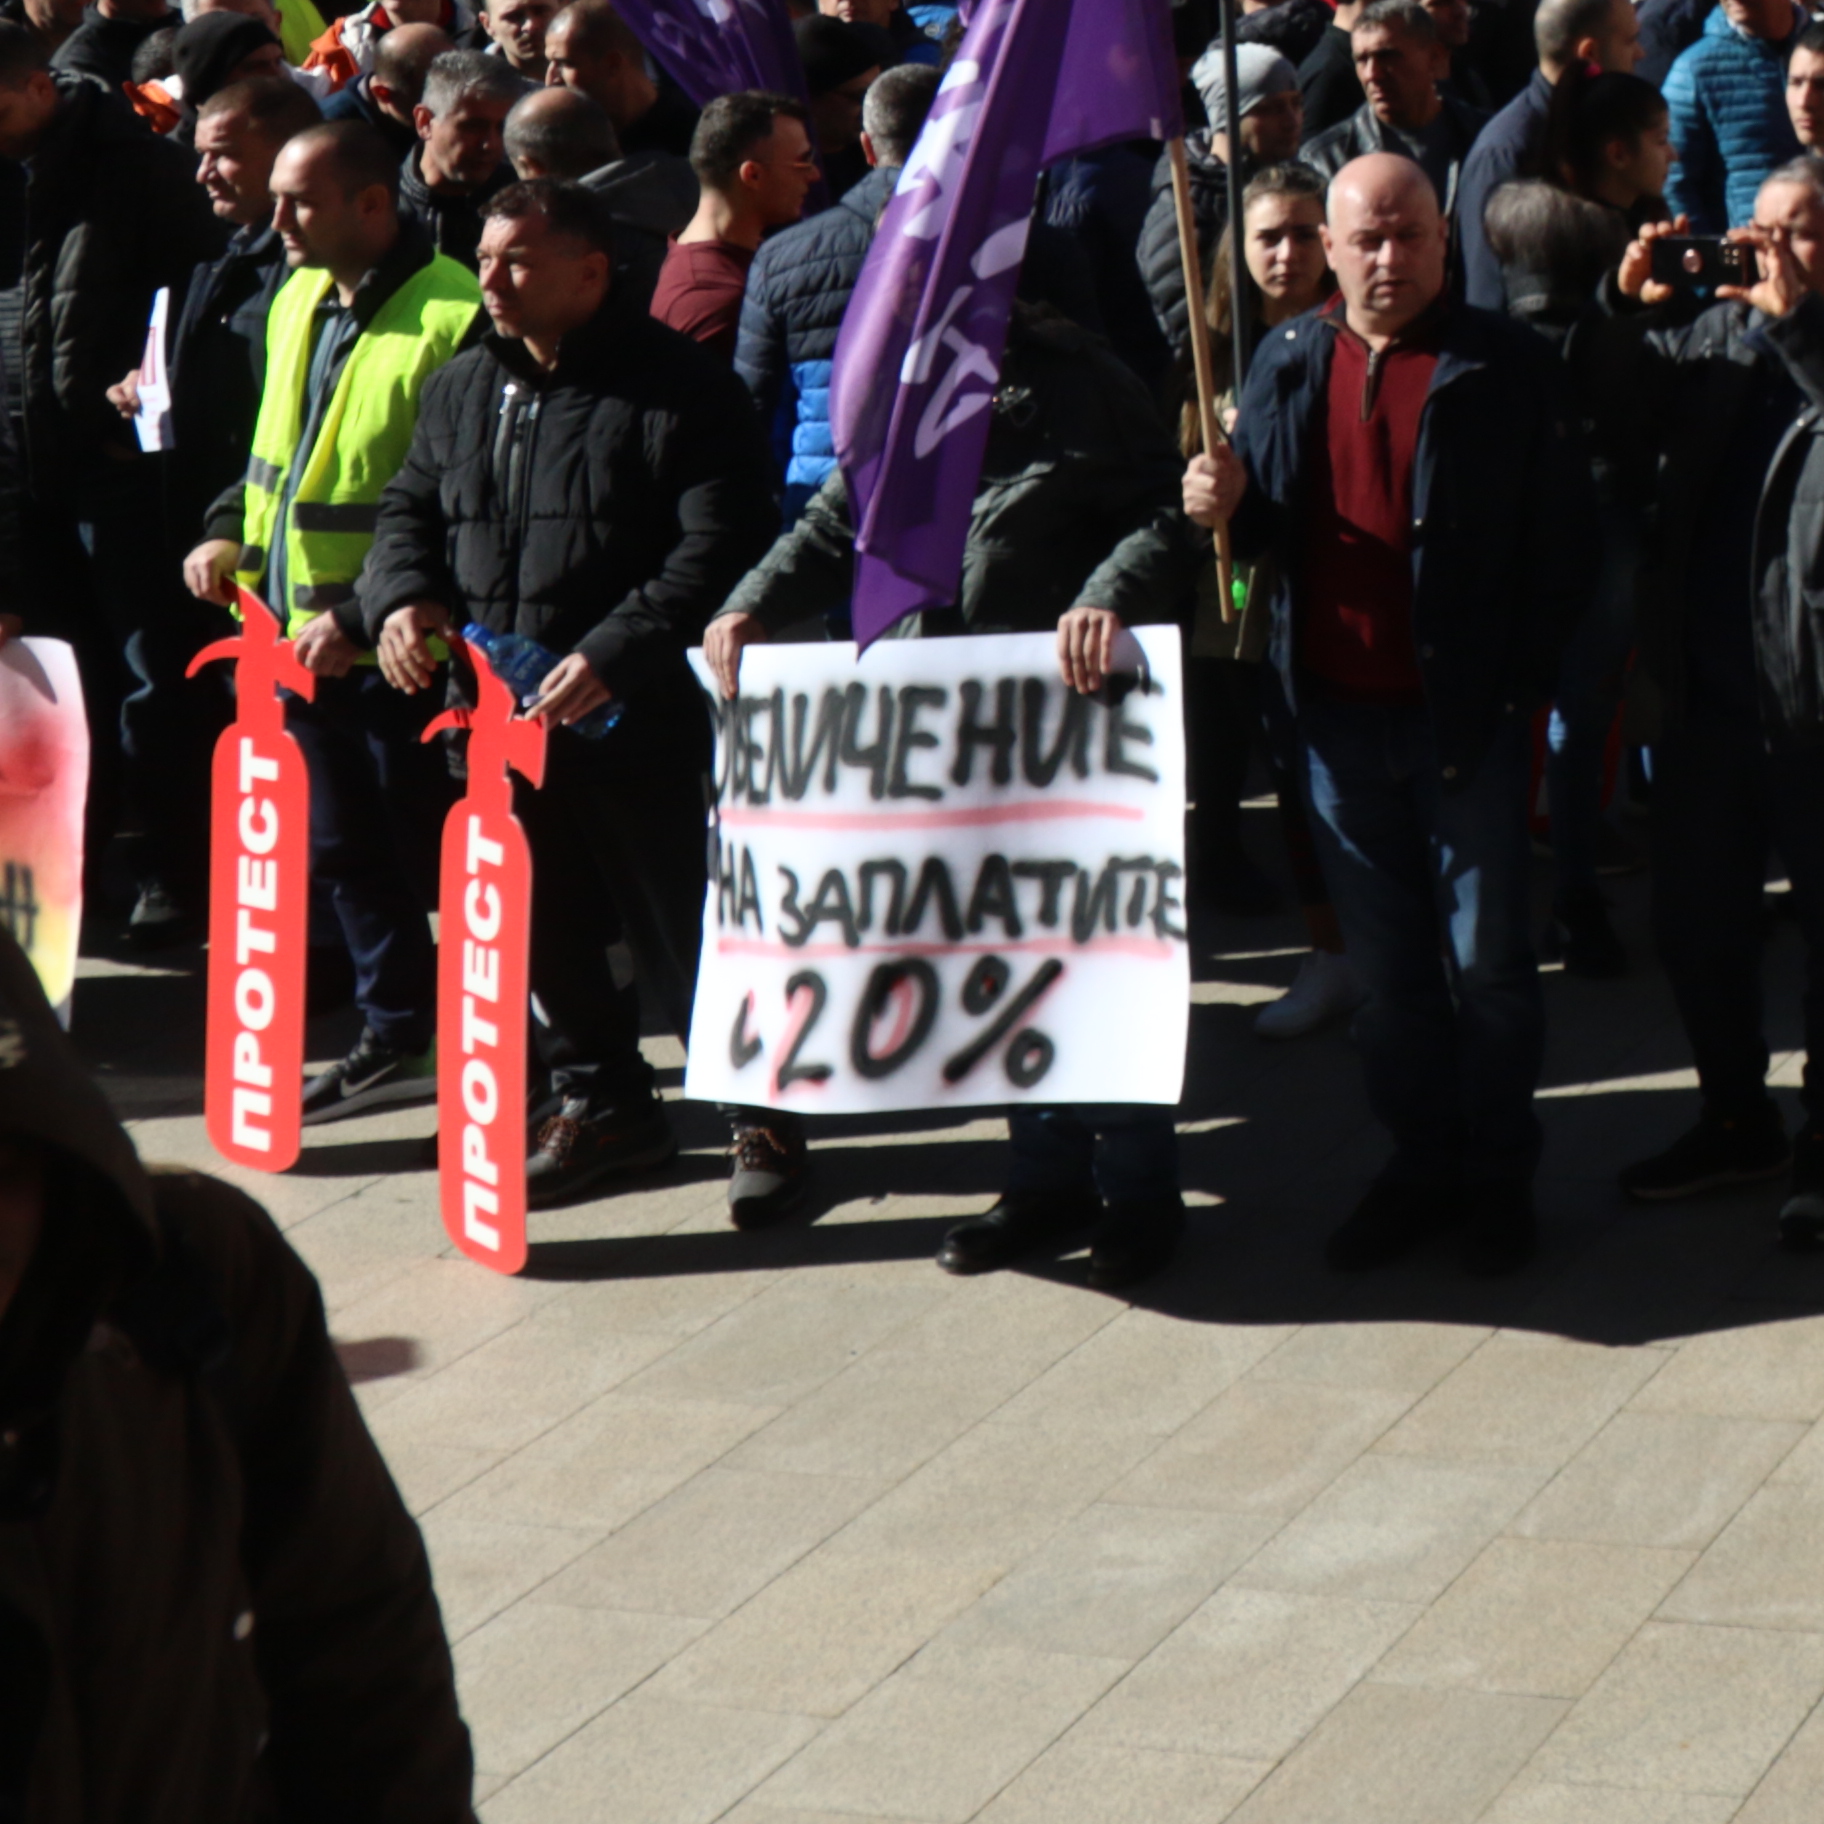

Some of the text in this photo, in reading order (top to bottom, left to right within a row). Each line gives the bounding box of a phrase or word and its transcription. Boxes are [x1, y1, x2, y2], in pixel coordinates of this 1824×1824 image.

[232, 738, 279, 1153] ПРОТЕСТ
[462, 815, 504, 1251] ПРОТЕСТ
[717, 841, 1189, 948] НА ЗАПЛАТИТЕ
[772, 954, 1065, 1093] 20%
